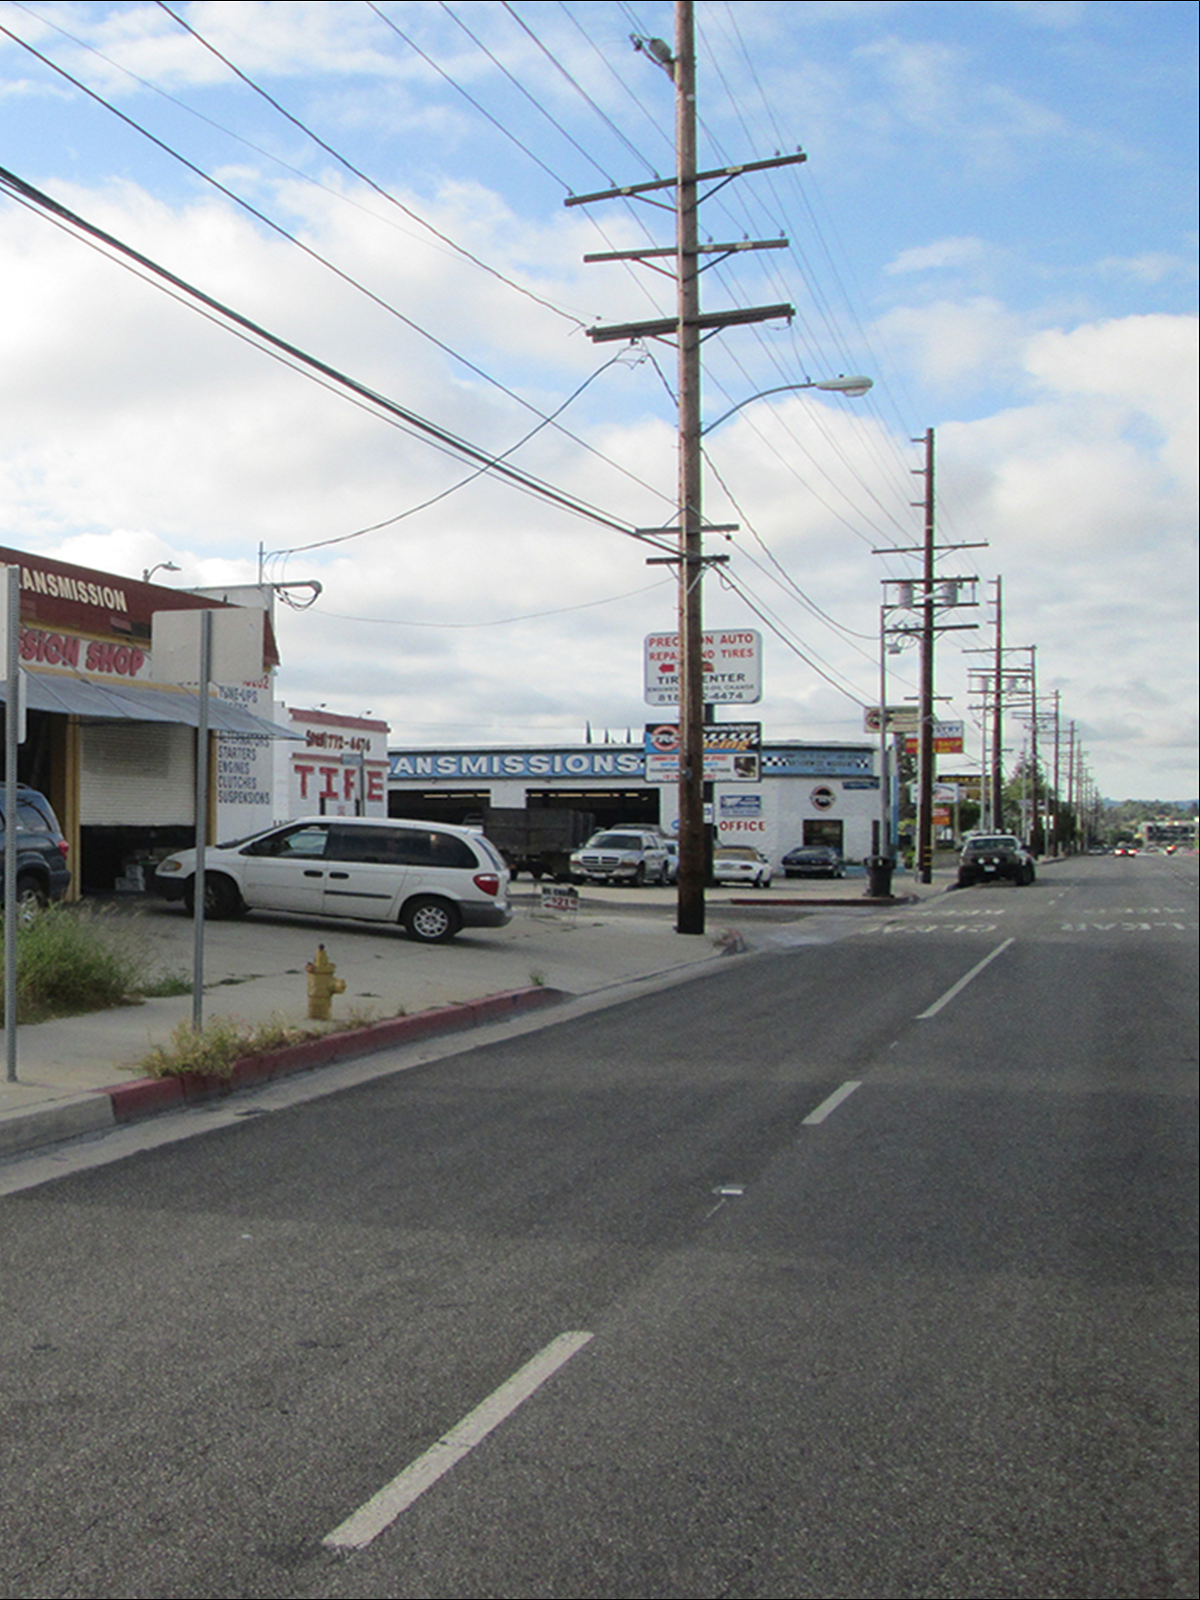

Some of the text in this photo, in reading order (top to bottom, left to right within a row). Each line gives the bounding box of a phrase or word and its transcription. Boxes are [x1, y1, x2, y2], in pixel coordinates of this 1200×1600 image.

[719, 633, 754, 645] AUTO
[85, 641, 144, 677] SHOP
[648, 648, 754, 662] REPA ND TIRES
[657, 673, 746, 685] TIR ENTER
[218, 685, 259, 704] TUNE-UPS
[218, 745, 257, 762] STARTERS
[218, 759, 251, 776] ENGINES
[388, 753, 640, 776] ANSMISSIONS
[218, 774, 258, 791] CLUTCHES
[218, 789, 271, 806] SUSPENSIONS
[719, 820, 766, 832] OFFICE
